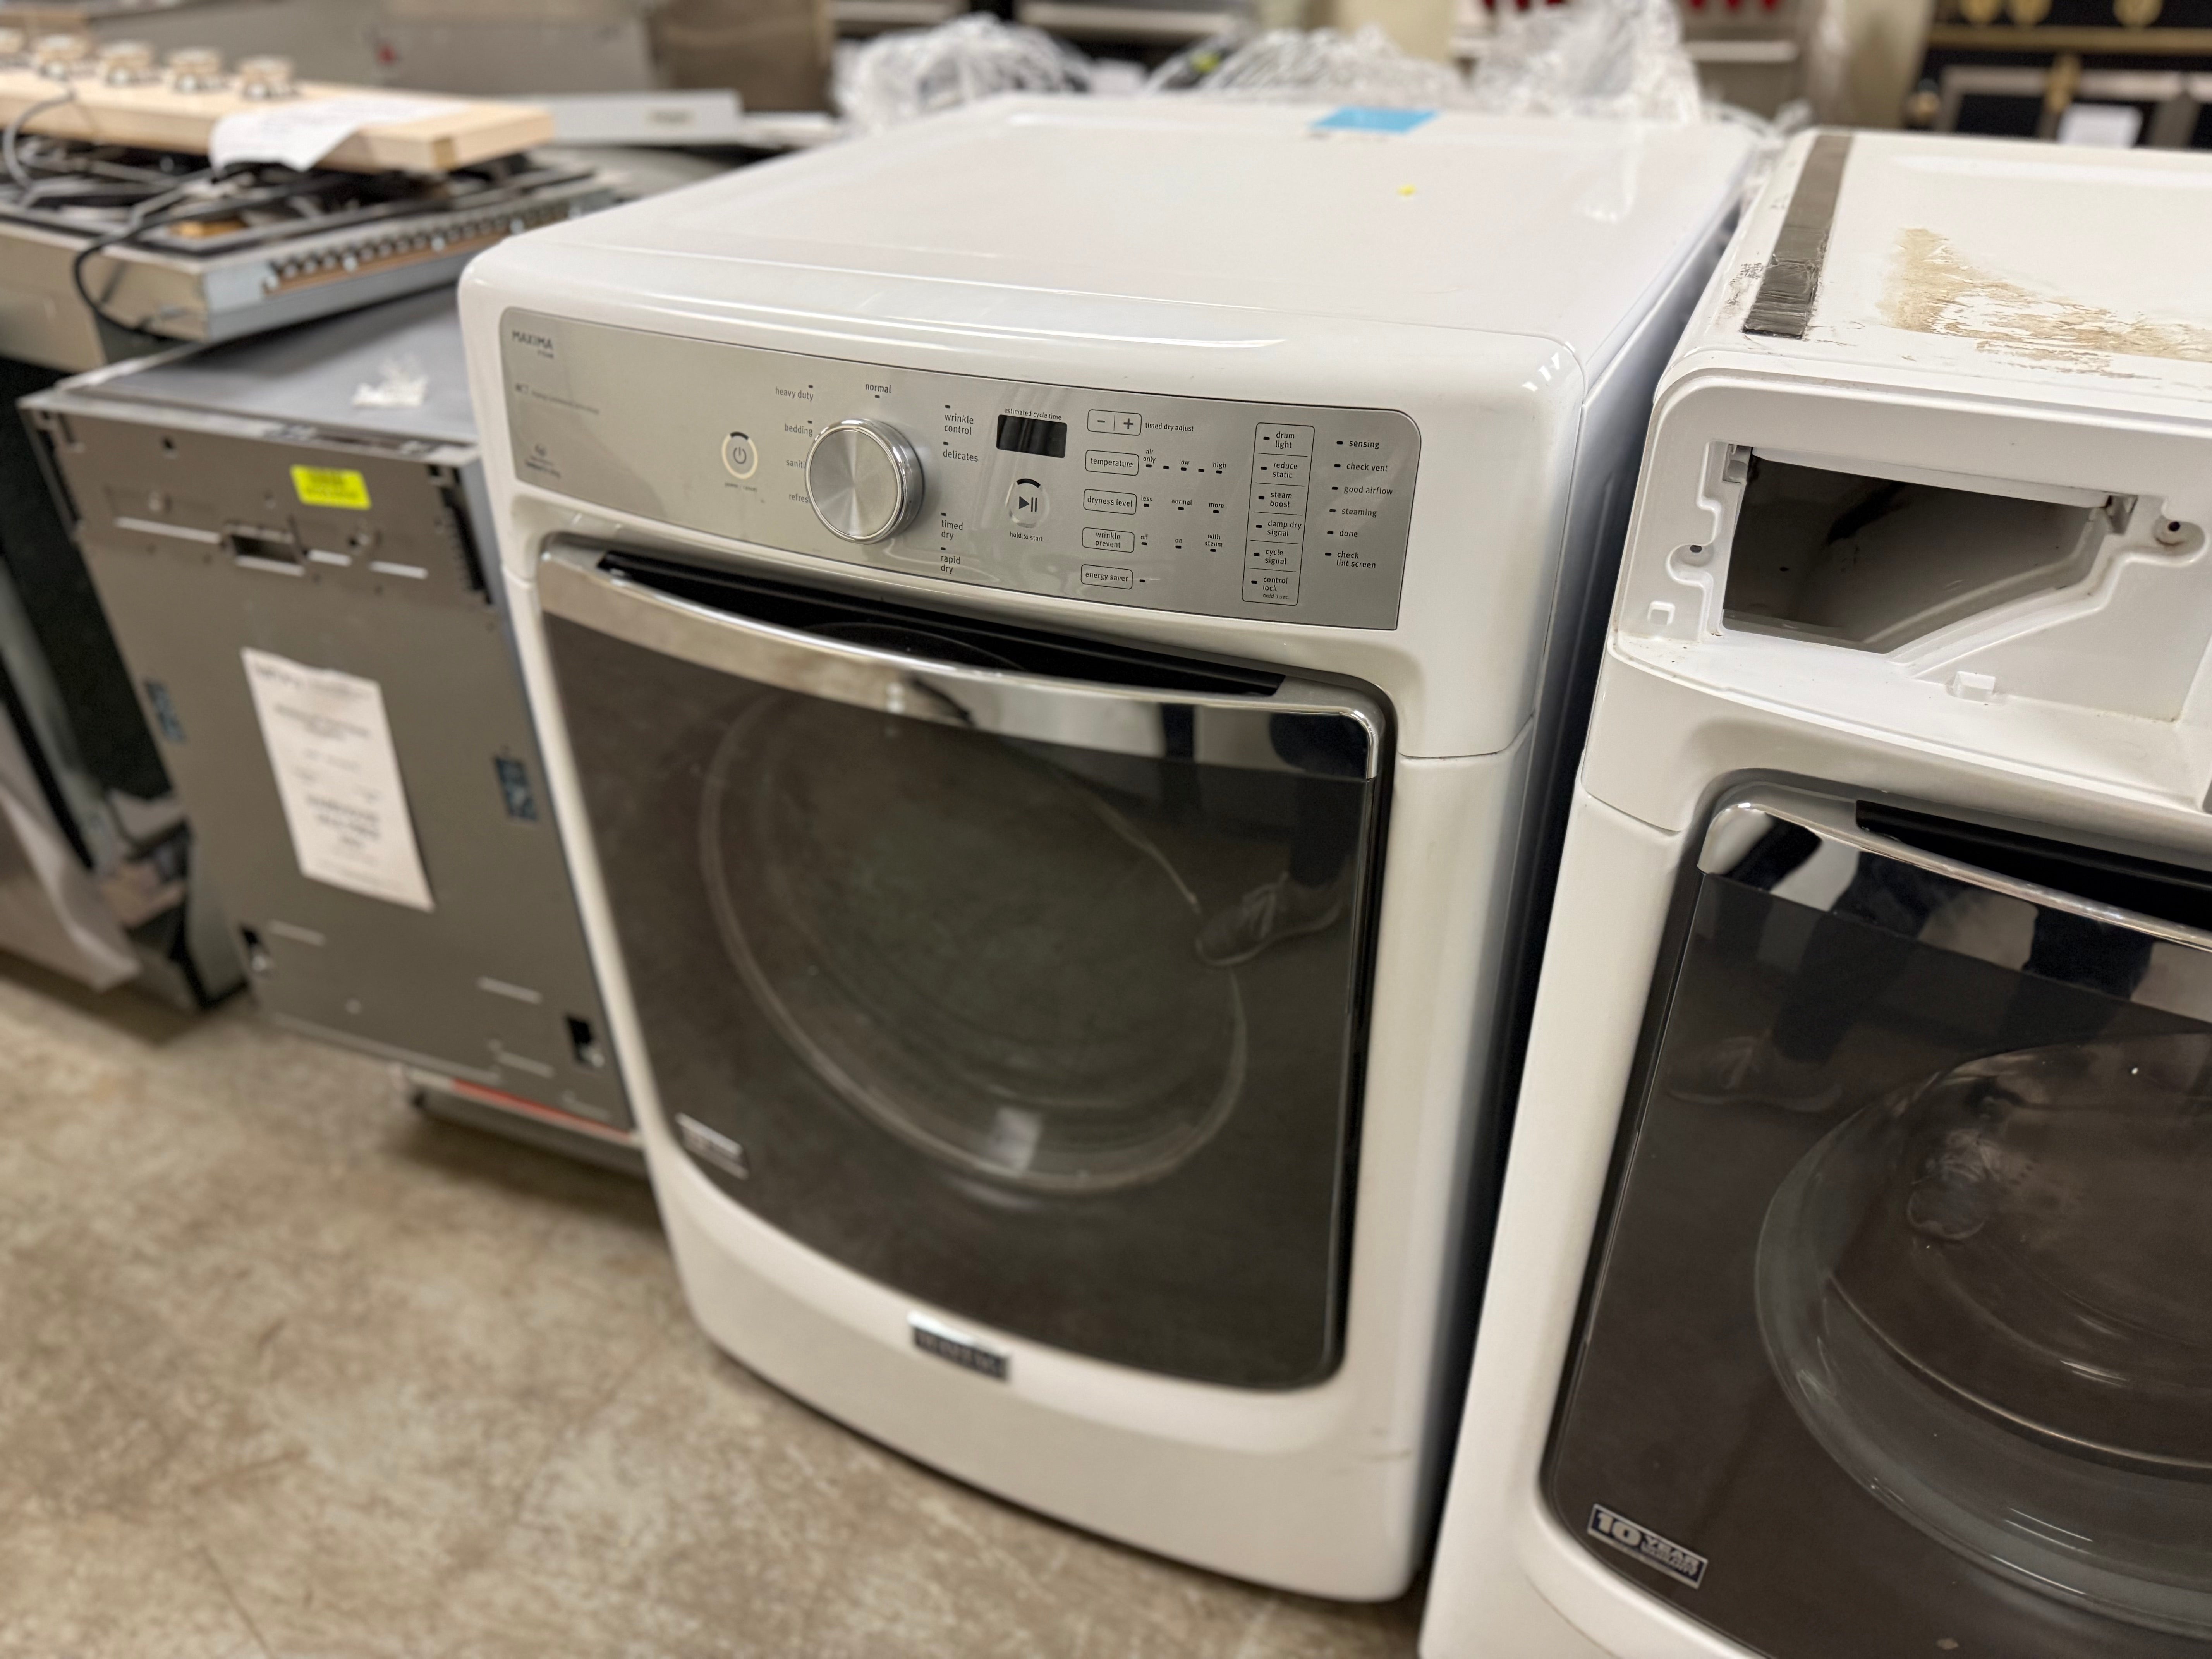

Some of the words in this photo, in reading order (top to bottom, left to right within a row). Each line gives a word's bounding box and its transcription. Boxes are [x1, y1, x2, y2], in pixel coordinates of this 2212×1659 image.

[866, 383, 891, 393] normal
[775, 386, 795, 399] heavy
[798, 390, 813, 401] duty
[1004, 408, 1031, 417] estimated
[945, 413, 974, 424] wrinkle
[784, 424, 812, 437] bedding
[944, 424, 972, 435] control
[1349, 440, 1379, 449] sensing
[943, 450, 978, 462] delicates
[786, 459, 805, 469] saniti
[1091, 457, 1133, 469] temperature
[1344, 486, 1363, 495] good
[1366, 487, 1393, 495] airflow
[789, 493, 809, 503] refres
[1087, 496, 1114, 507] dryness
[1116, 498, 1132, 507] level
[1342, 508, 1377, 518] steaming
[941, 520, 963, 530] timed
[941, 530, 954, 540] dry
[1096, 532, 1120, 540] wrinkle
[1095, 540, 1120, 549] prevent
[941, 555, 960, 565] rapid
[941, 564, 953, 574] dry
[1085, 571, 1108, 581] energy
[1110, 574, 1128, 582] saver
[1597, 1513, 1642, 1546] 10
